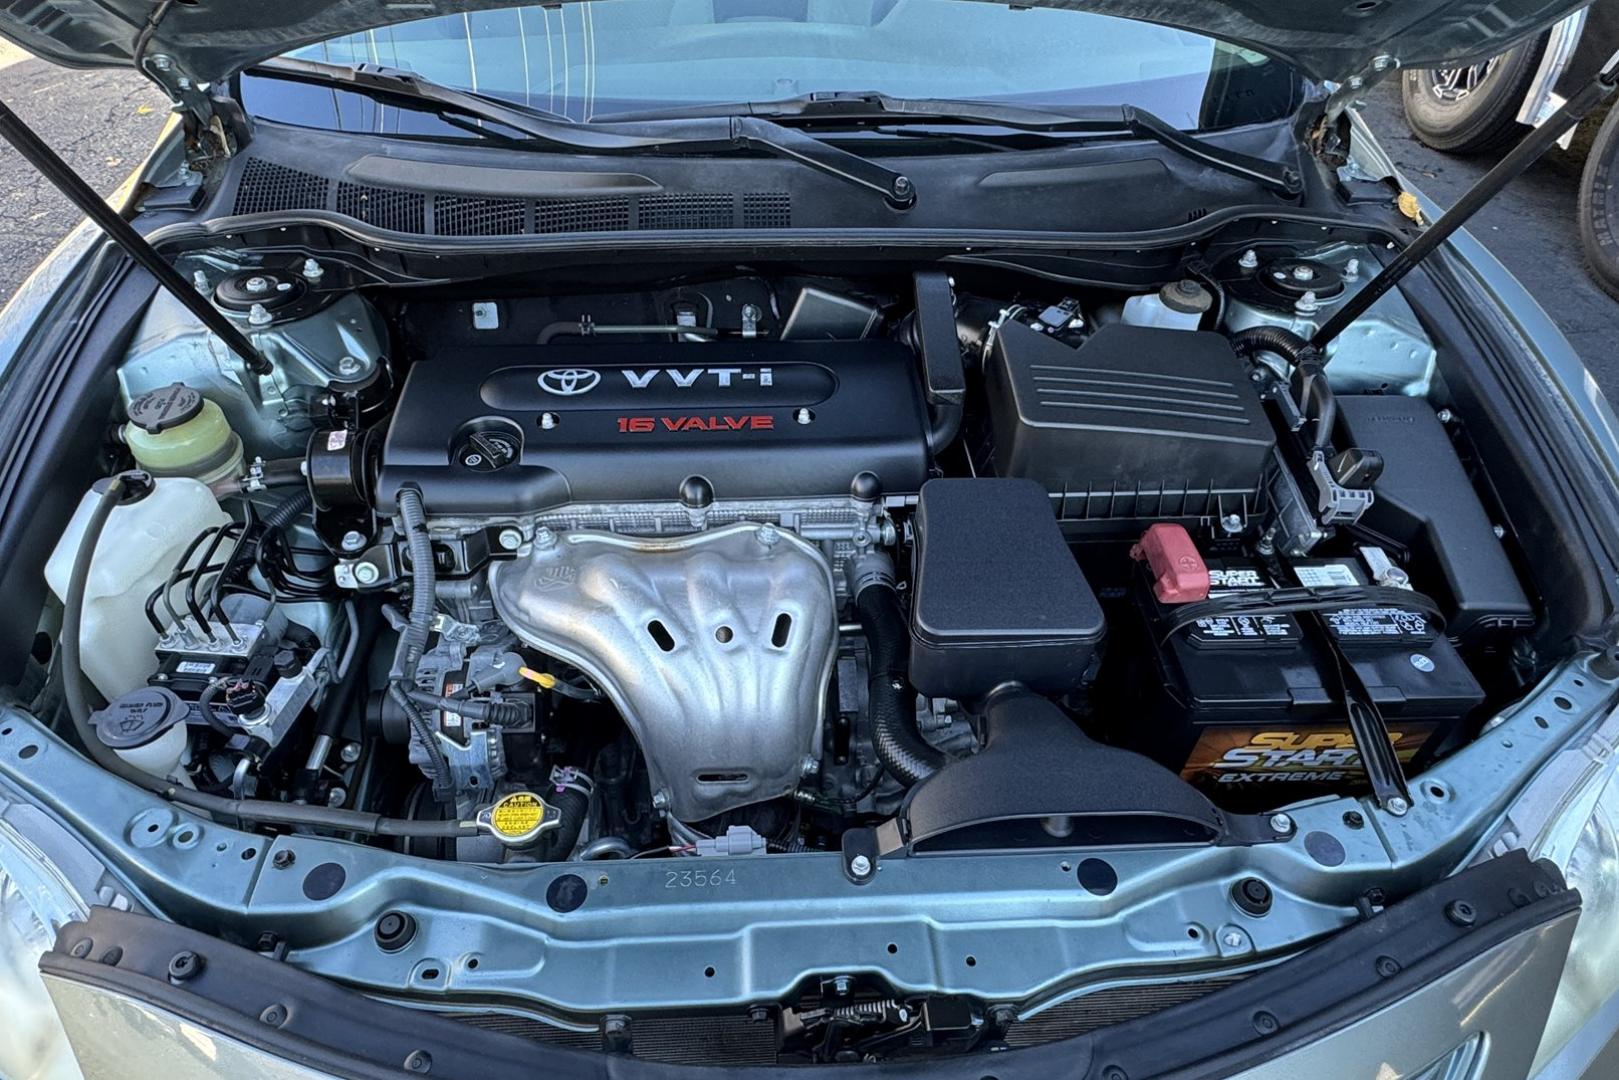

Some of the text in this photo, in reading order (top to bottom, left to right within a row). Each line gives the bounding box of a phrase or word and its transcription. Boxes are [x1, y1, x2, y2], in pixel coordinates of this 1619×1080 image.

[621, 368, 773, 388] VVT-i
[617, 415, 774, 433] 16 VALVE
[1208, 570, 1260, 580] SUPER
[1213, 748, 1362, 769] STAR
[1219, 772, 1344, 783] EXTREME
[664, 868, 736, 888] 23564
